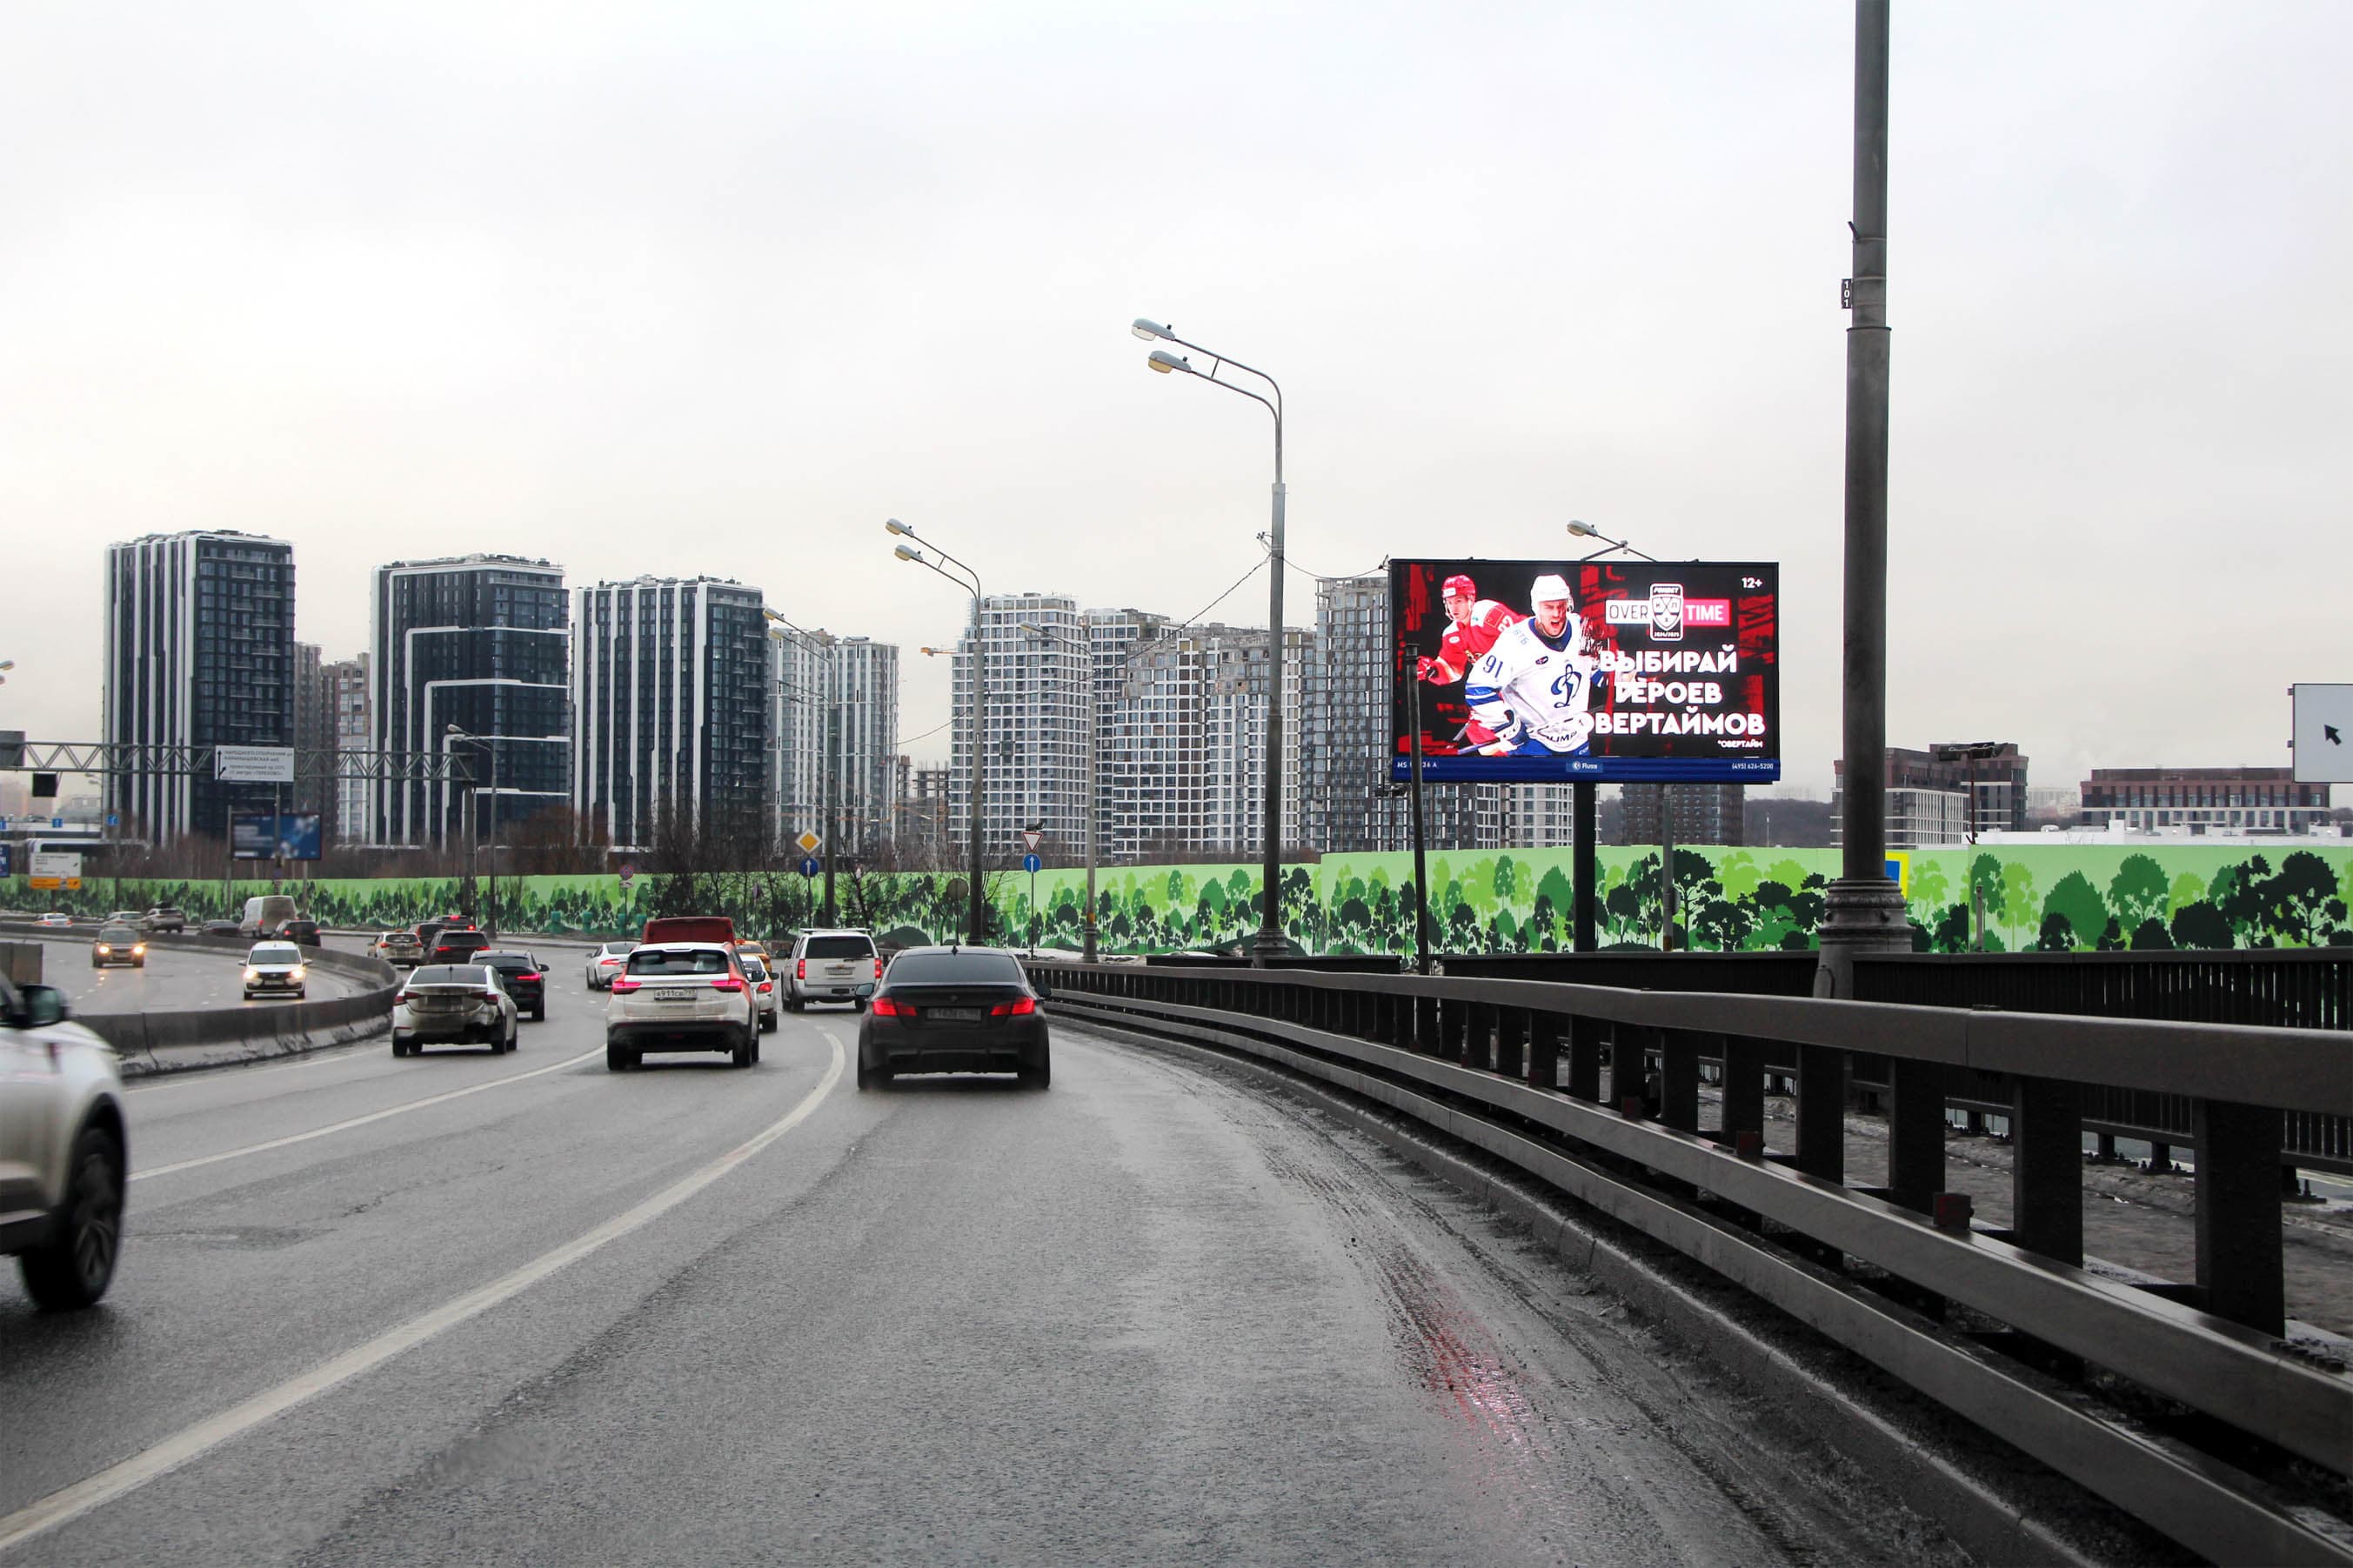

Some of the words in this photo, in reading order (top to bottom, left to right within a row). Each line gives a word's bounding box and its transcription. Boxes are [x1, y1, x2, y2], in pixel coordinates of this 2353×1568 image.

[1741, 577, 1762, 589] 12+
[1609, 604, 1648, 619] OVER
[1686, 604, 1724, 621] TIME
[1482, 655, 1504, 678] 91
[1599, 644, 1738, 673] ВЫБИРАЙ
